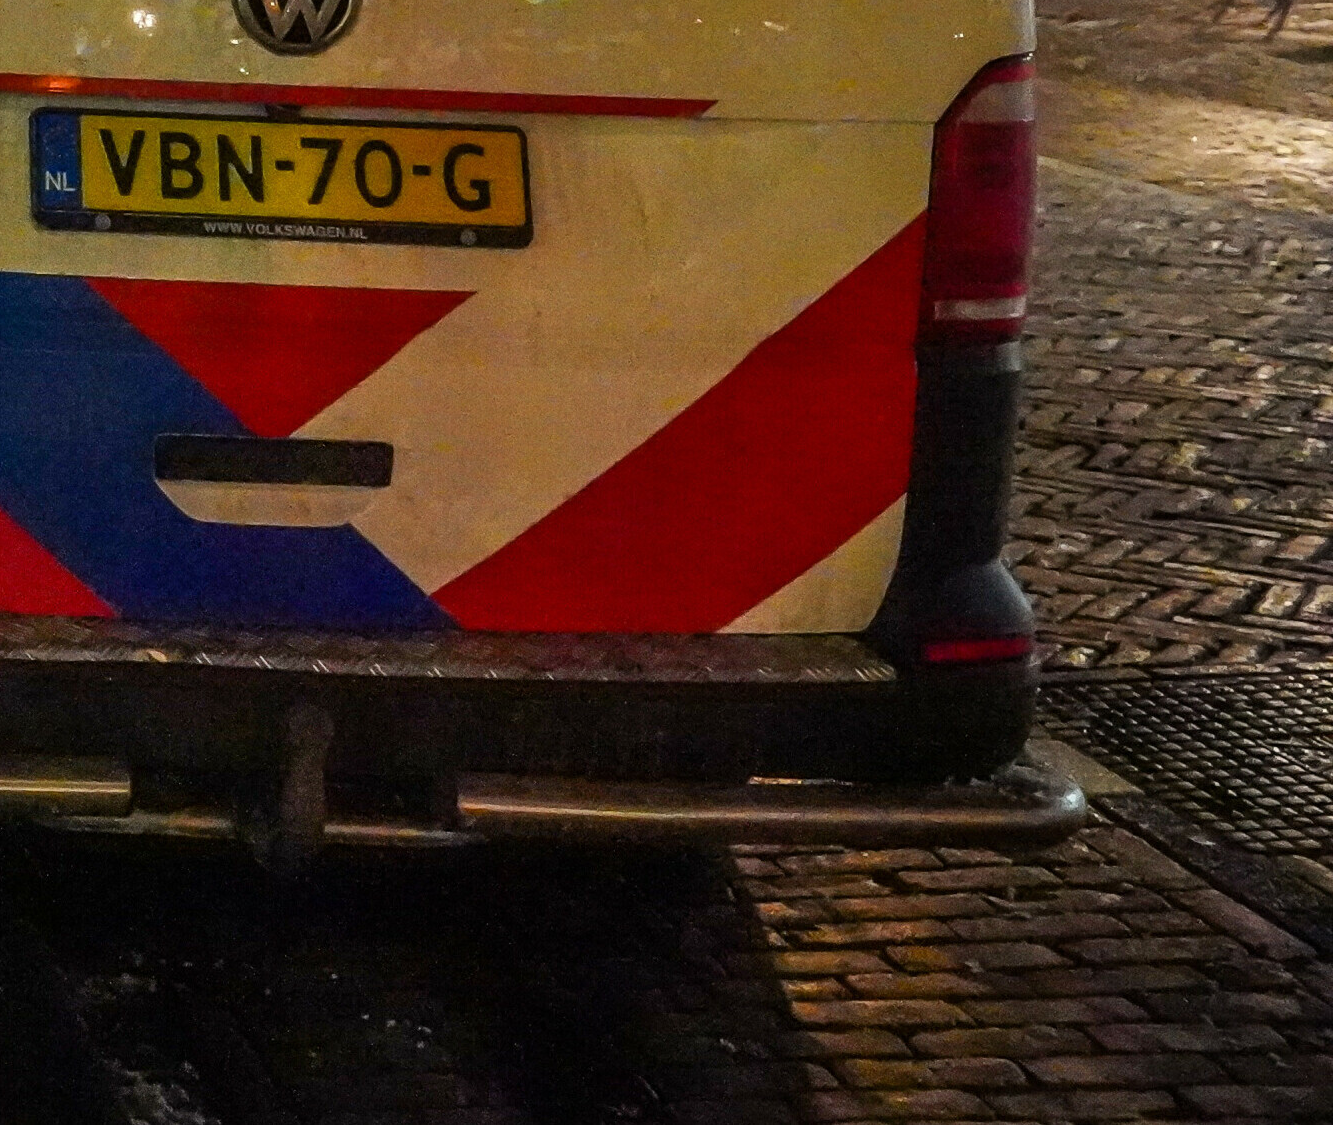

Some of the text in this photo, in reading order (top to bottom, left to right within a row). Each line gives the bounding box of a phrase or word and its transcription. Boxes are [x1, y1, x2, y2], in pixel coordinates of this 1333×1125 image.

[98, 127, 492, 213] VBN-70-G
[44, 171, 76, 192] NL
[203, 221, 369, 240] WWW.VOLKSWAGEN.NL
